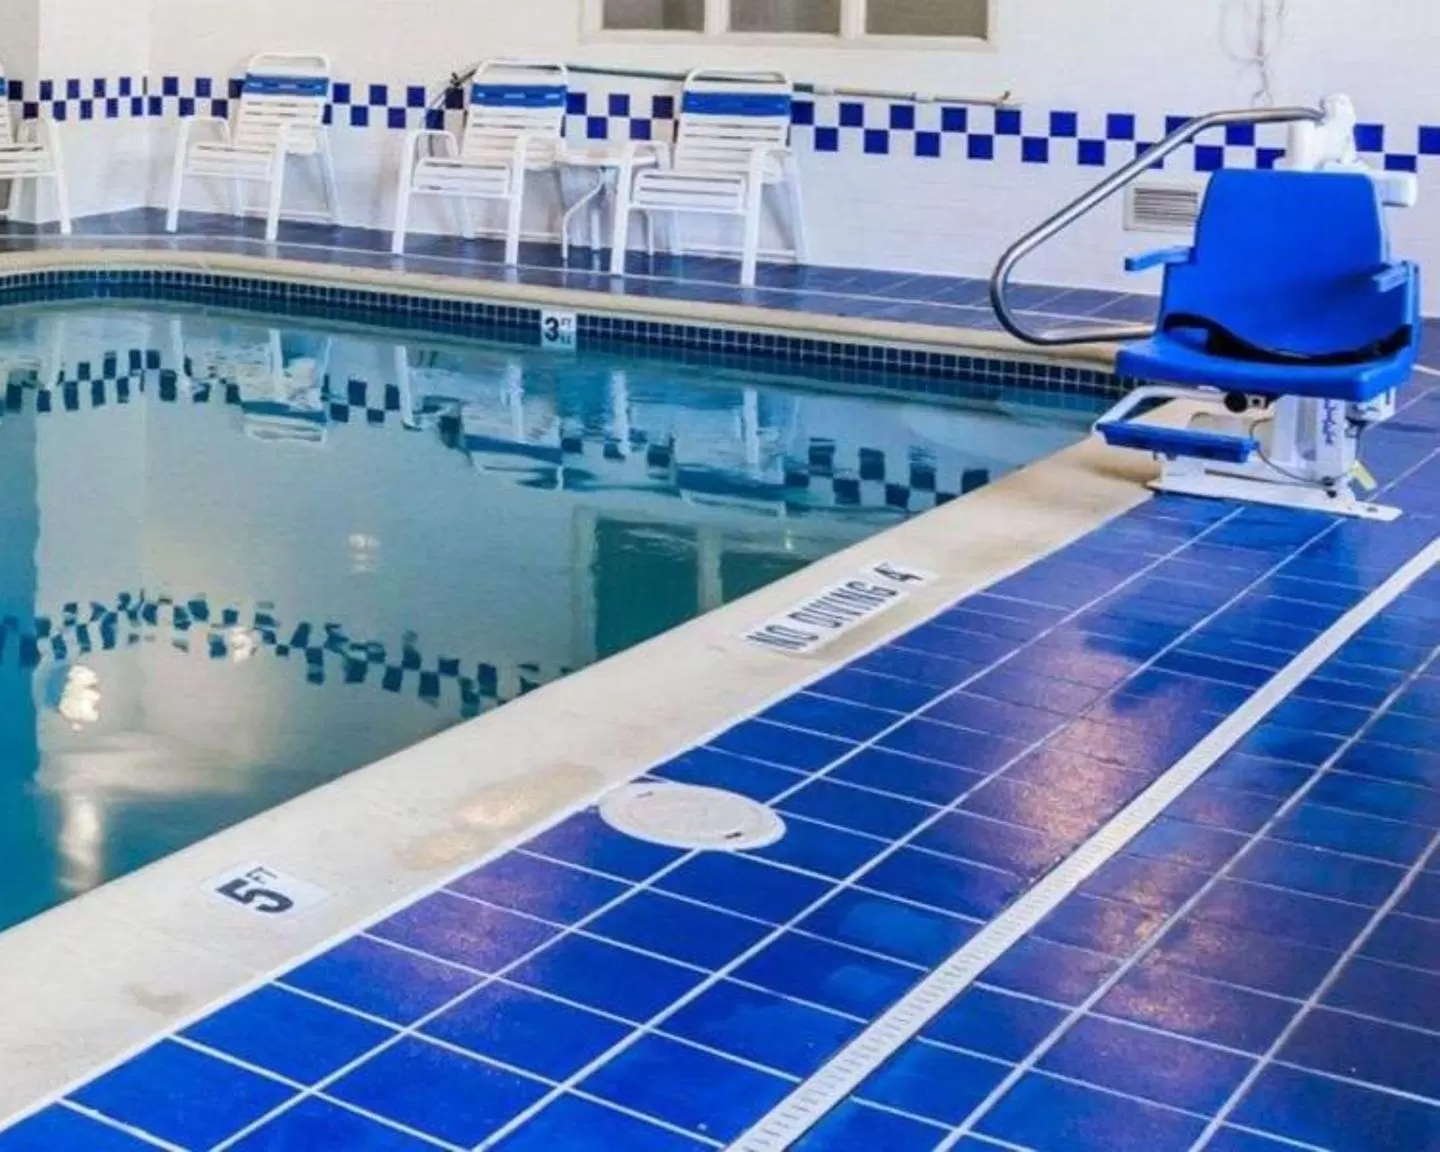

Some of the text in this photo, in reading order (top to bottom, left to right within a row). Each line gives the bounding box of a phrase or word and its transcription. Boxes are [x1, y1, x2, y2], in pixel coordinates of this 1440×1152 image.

[544, 316, 559, 342] 3
[746, 624, 819, 649] NO
[787, 580, 898, 629] DIVING
[214, 877, 295, 914] 5
